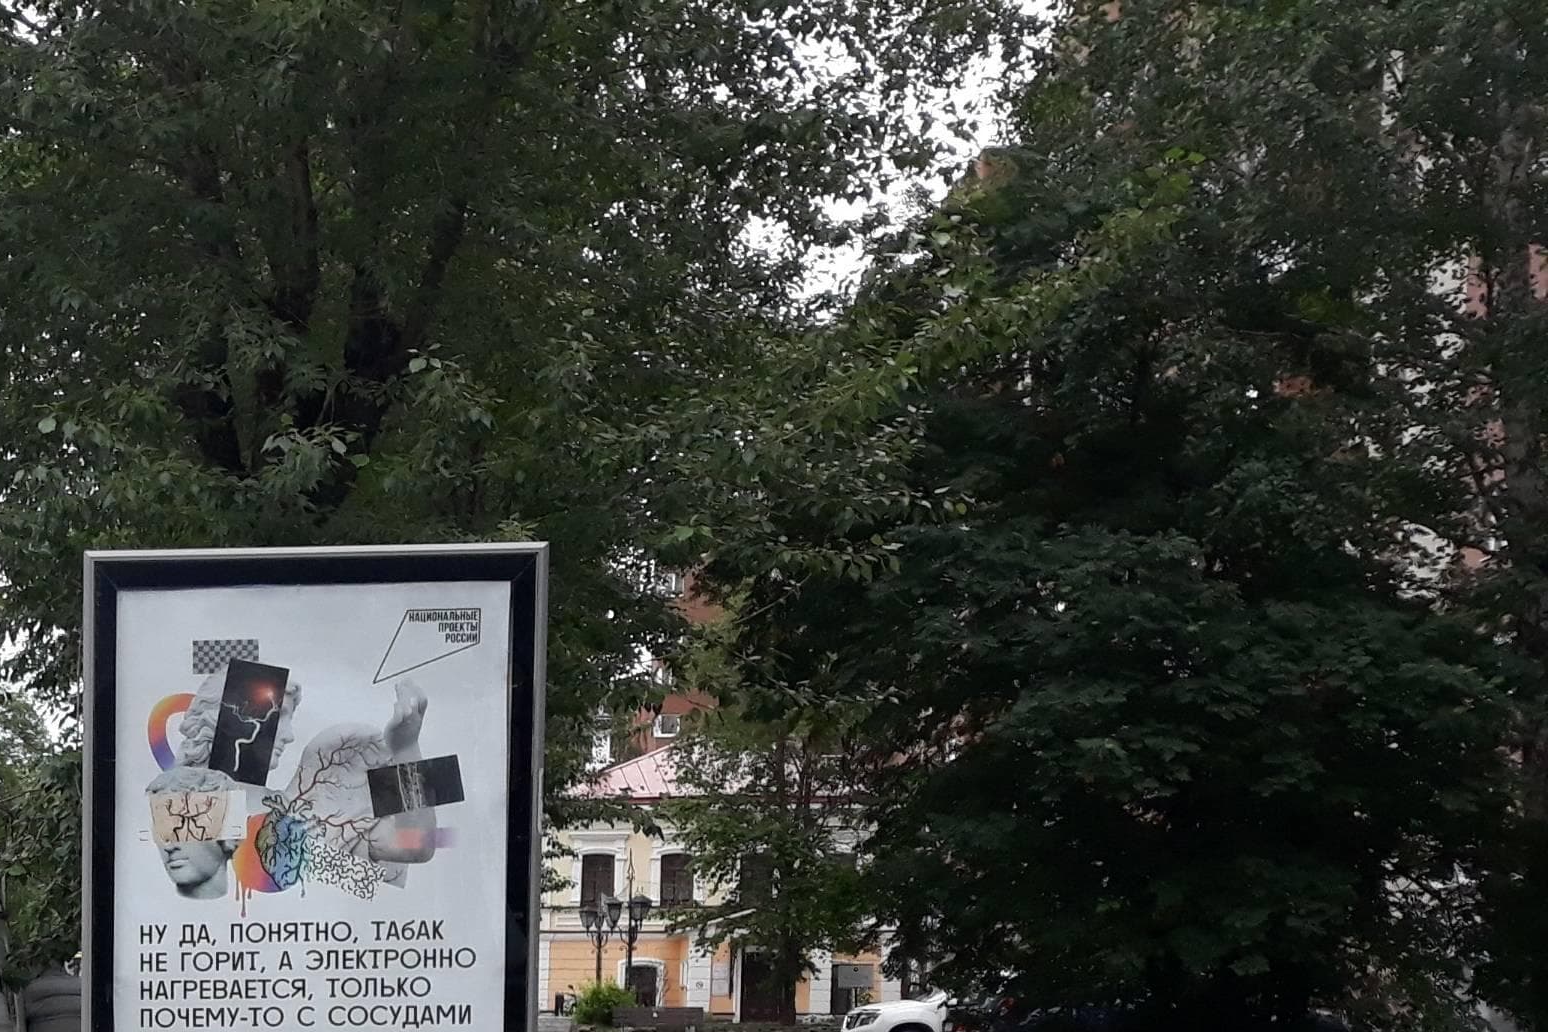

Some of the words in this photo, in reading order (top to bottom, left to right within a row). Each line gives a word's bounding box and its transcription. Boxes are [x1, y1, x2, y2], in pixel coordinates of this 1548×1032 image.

[408, 611, 478, 623] НАЦИОНАЛЬНЫЕ
[438, 622, 478, 633] ПРОЕКТЫ
[444, 632, 478, 643] РОССИИ
[140, 924, 168, 945] НУ
[179, 924, 217, 948] ДА,
[230, 921, 358, 944] ПОНЯТНО,
[140, 952, 168, 973] НЕ
[180, 950, 266, 973] ГОРИТ,
[278, 950, 293, 971] А
[305, 947, 477, 971] ЭЛЕКТРОННО
[140, 978, 313, 1001] НАГРЕВАЕТСЯ,
[325, 976, 431, 999] ТОЛЬКО
[140, 1006, 285, 1029] ПОЧЕМУ-ТО
[297, 1006, 315, 1027] С
[328, 1004, 472, 1029] СОСУДАМИ
